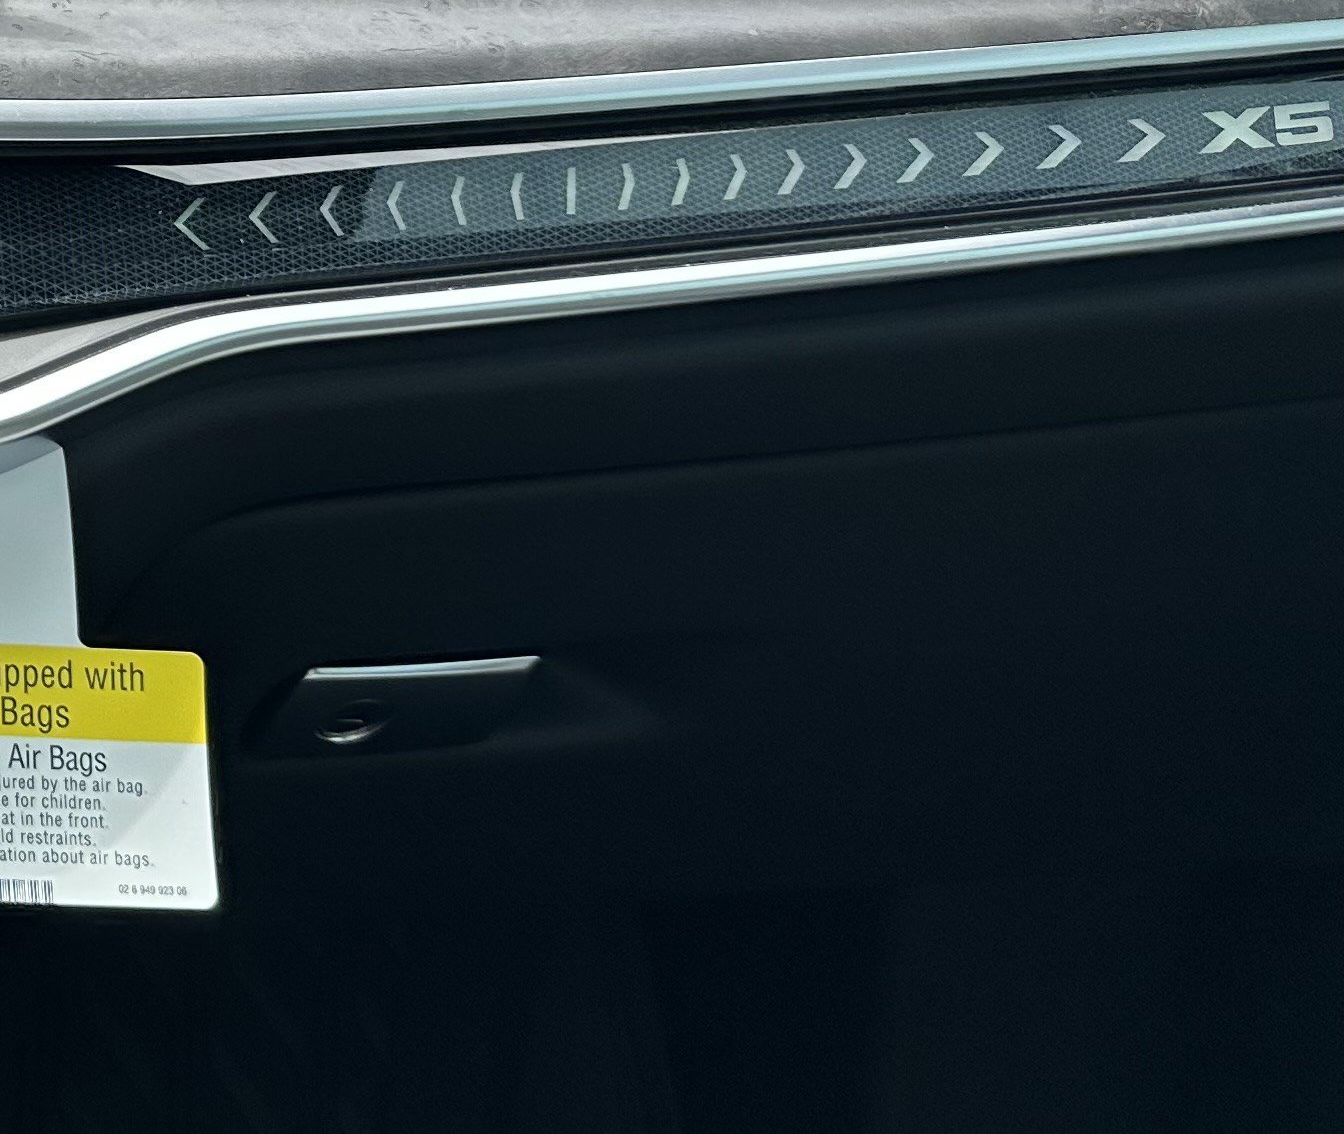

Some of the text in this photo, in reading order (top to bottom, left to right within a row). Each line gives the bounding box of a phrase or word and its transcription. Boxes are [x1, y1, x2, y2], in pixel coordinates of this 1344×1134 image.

[1199, 101, 1334, 154] X5
[84, 661, 145, 692] with
[1, 695, 71, 735] Bags
[8, 744, 42, 770] Air
[49, 745, 108, 777] Bags
[41, 776, 58, 794] by
[64, 777, 87, 792] the
[92, 778, 111, 793] air
[117, 778, 148, 797] bag.
[15, 792, 37, 807] for
[41, 793, 107, 811] children.
[20, 812, 34, 826] in
[40, 812, 63, 827] the
[68, 812, 109, 829] front.
[20, 830, 97, 847] restraints.
[42, 848, 84, 864] about
[90, 850, 109, 865] air
[114, 850, 155, 869] bags.
